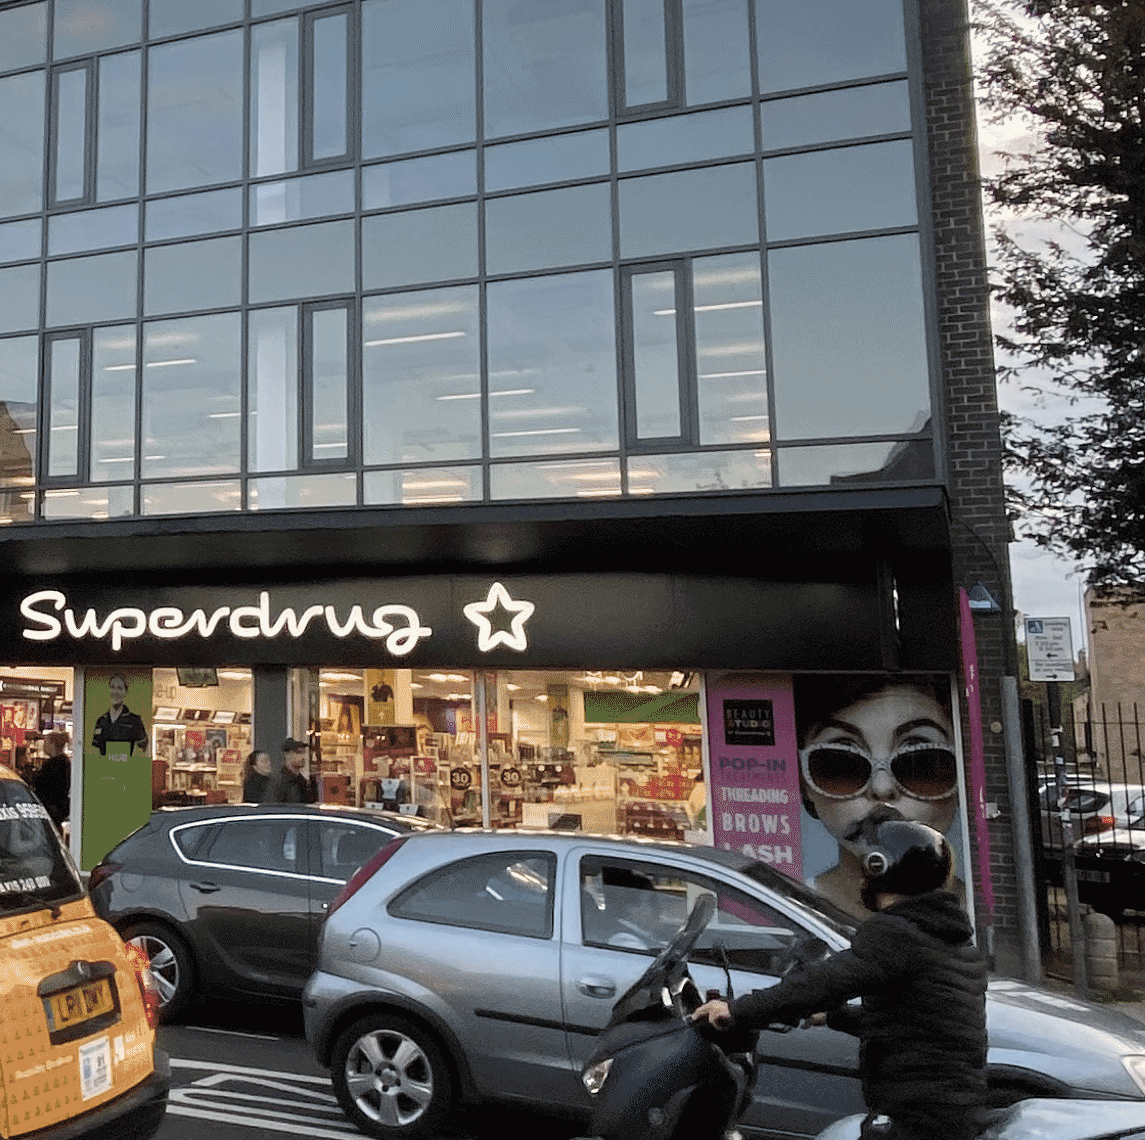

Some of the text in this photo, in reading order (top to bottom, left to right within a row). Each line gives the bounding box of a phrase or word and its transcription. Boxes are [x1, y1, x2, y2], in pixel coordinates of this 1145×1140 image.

[20, 589, 433, 656] Superdrug
[719, 757, 786, 771] POP-IN
[721, 786, 789, 804] THREADING
[722, 812, 791, 835] BROWS
